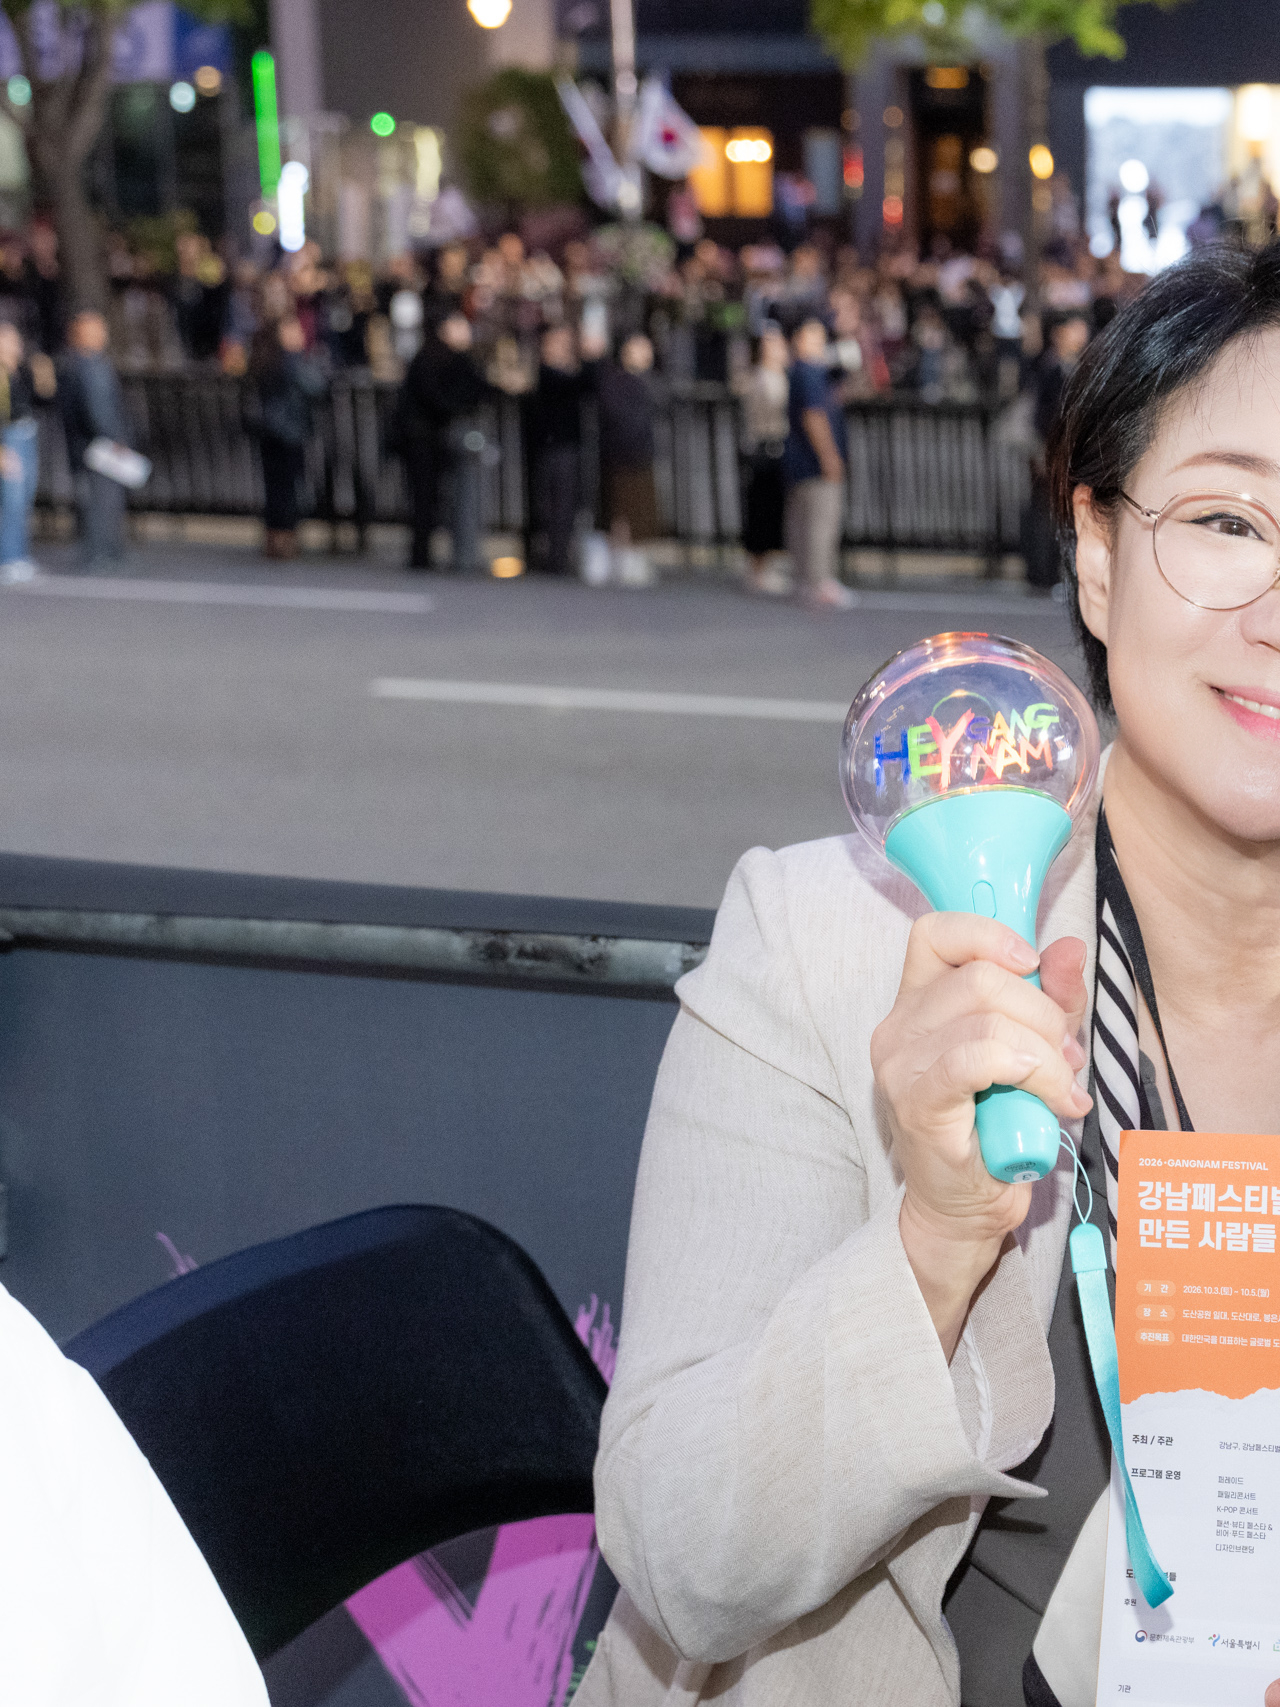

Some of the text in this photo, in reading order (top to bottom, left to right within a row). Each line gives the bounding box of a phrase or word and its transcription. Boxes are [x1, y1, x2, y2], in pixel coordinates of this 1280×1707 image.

[964, 702, 1060, 748] GANG
[874, 708, 975, 797] HEY
[970, 736, 1053, 780] NAM
[1221, 1160, 1269, 1171] FESTIVAL
[1138, 1218, 1277, 1253] 만든 사람들
[1183, 1285, 1233, 1297] 2026.10.3.(토)
[1240, 1287, 1270, 1298] 10.5.(월)
[1182, 1309, 1212, 1320] 도산공원
[1231, 1311, 1262, 1323] 도산대로,
[1140, 1332, 1170, 1342] 추진목표
[1181, 1333, 1218, 1345] 대한민국을
[1219, 1335, 1249, 1347] 대표하는
[1249, 1337, 1272, 1348] 글로벌
[1131, 1433, 1149, 1445] 주최
[1157, 1435, 1174, 1447] 주관
[1242, 1442, 1280, 1454] 강남페스티벌
[1130, 1467, 1182, 1481] 프로그램 운영
[1218, 1475, 1244, 1485] 퍼레이드
[1217, 1490, 1257, 1501] 패밀리콘서트
[1216, 1505, 1259, 1516] K-POP 콘서트
[1246, 1521, 1267, 1531] 페스타
[1246, 1531, 1266, 1540] 페스타
[1215, 1543, 1255, 1554] 디자인브랜딩
[1124, 1598, 1137, 1607] 후원
[1220, 1638, 1261, 1650] 서울특별시
[1117, 1684, 1132, 1694] 기관
